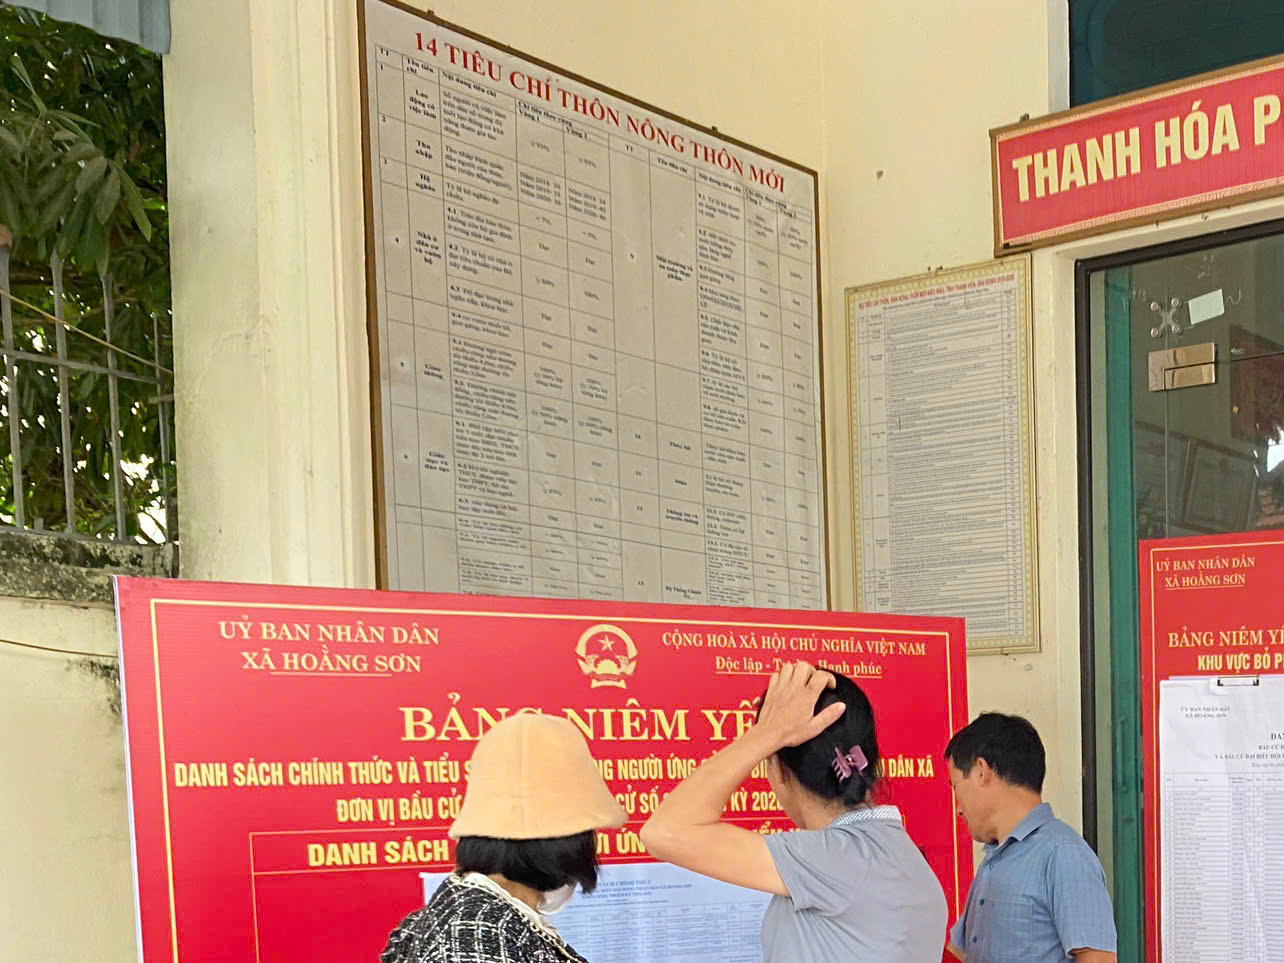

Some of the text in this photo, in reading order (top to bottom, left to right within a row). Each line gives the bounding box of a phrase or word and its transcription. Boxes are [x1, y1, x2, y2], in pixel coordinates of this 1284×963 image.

[415, 32, 785, 193] 14 TIÊU CHÍ THÔN NÔNG THÔN MỚI
[1012, 127, 1140, 201] THANH
[1154, 100, 1241, 169] HÓA
[1173, 560, 1195, 571] BAN
[1223, 573, 1246, 585] SƠN
[260, 621, 311, 641] BAN
[318, 619, 385, 644] NHÂN
[392, 620, 440, 645] DÂN
[663, 629, 703, 650] CỘNG
[739, 631, 757, 649] XÃ
[761, 634, 786, 653] HỘI
[790, 632, 818, 651] CHỦ
[821, 636, 864, 654] NGHĨA
[866, 637, 896, 657] VIỆT
[898, 641, 926, 656] NAM
[1168, 625, 1215, 648] BẢNG
[1219, 625, 1264, 646] NIÊM
[241, 643, 422, 673] XÃ HOẰNG SƠN
[716, 655, 740, 673] Độc
[743, 656, 763, 674] lập
[853, 659, 881, 677] phúc
[1197, 654, 1222, 671] KHU
[1226, 652, 1250, 674] VỰC
[1254, 646, 1271, 669] BỎ
[400, 692, 543, 742] BẢN
[174, 762, 228, 787] DANH
[233, 757, 284, 786] SÁCH
[289, 757, 344, 786] CHÍNH
[348, 755, 393, 784] THỨC
[397, 756, 420, 783] VÀ
[424, 752, 459, 783] TIỂU
[617, 753, 664, 780] NGƯỜI
[888, 754, 914, 778] DÂN
[918, 755, 934, 778] XÃ
[336, 797, 374, 823] ĐƠN
[377, 797, 396, 826] VỊ
[400, 790, 433, 820] BẦU
[438, 787, 463, 819] CỬ
[731, 787, 748, 811] KỲ
[308, 836, 449, 867] DANH SÁCH
